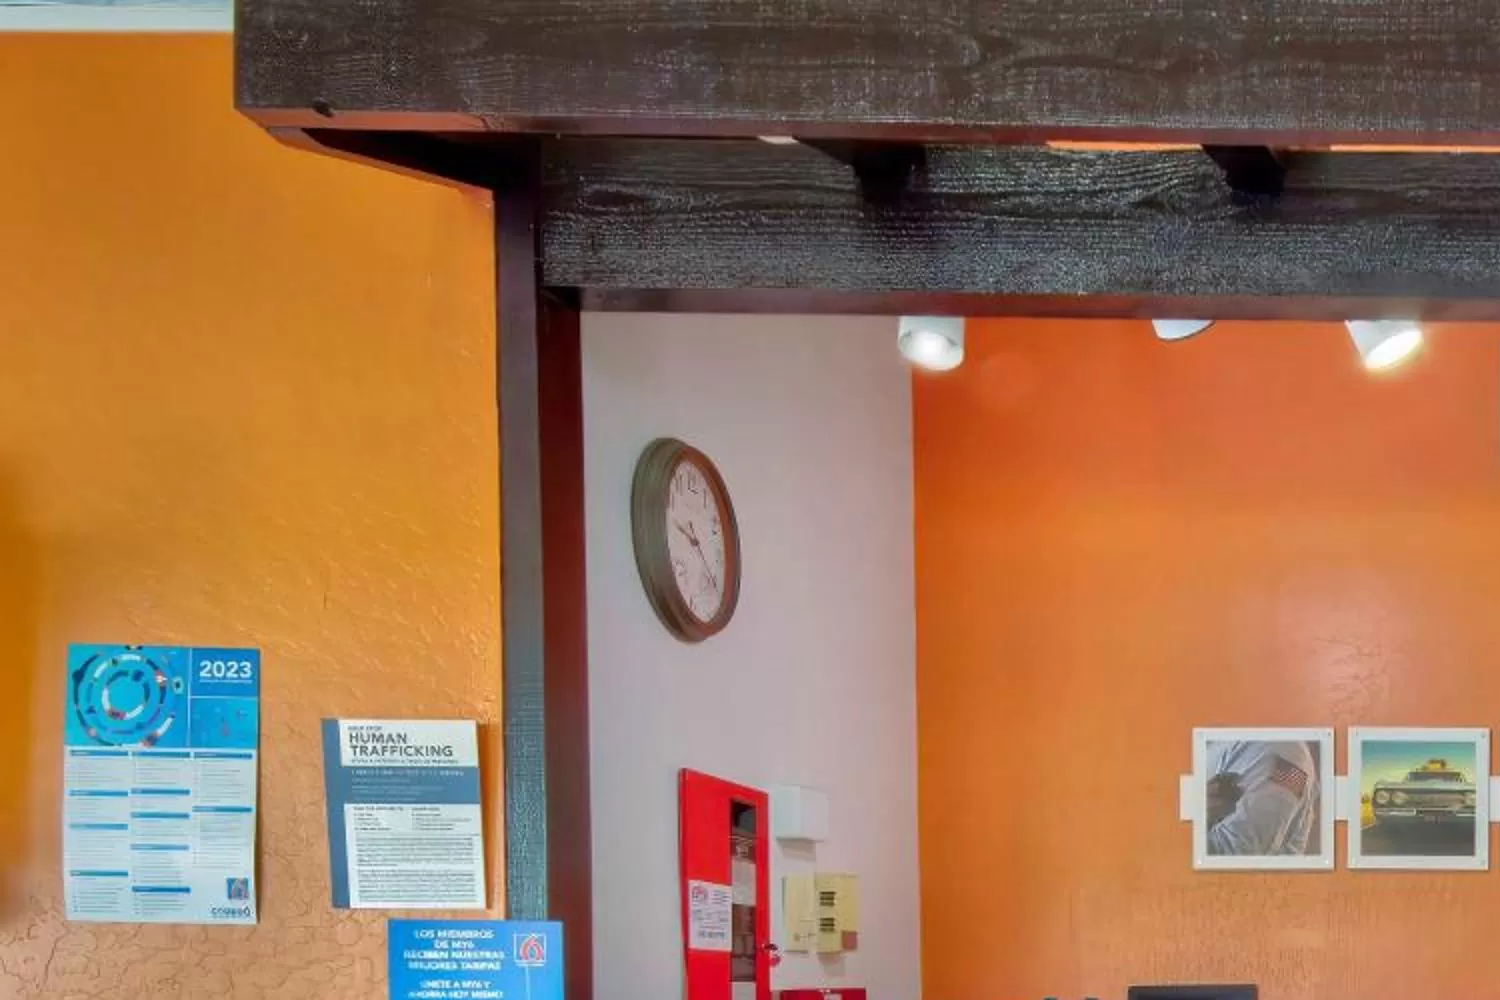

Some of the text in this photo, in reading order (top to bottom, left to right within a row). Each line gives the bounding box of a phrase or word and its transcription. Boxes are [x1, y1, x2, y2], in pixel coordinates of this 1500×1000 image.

[199, 660, 252, 678] 2023
[349, 731, 407, 744] HUMAN
[350, 745, 454, 757] TRAFFICKING
